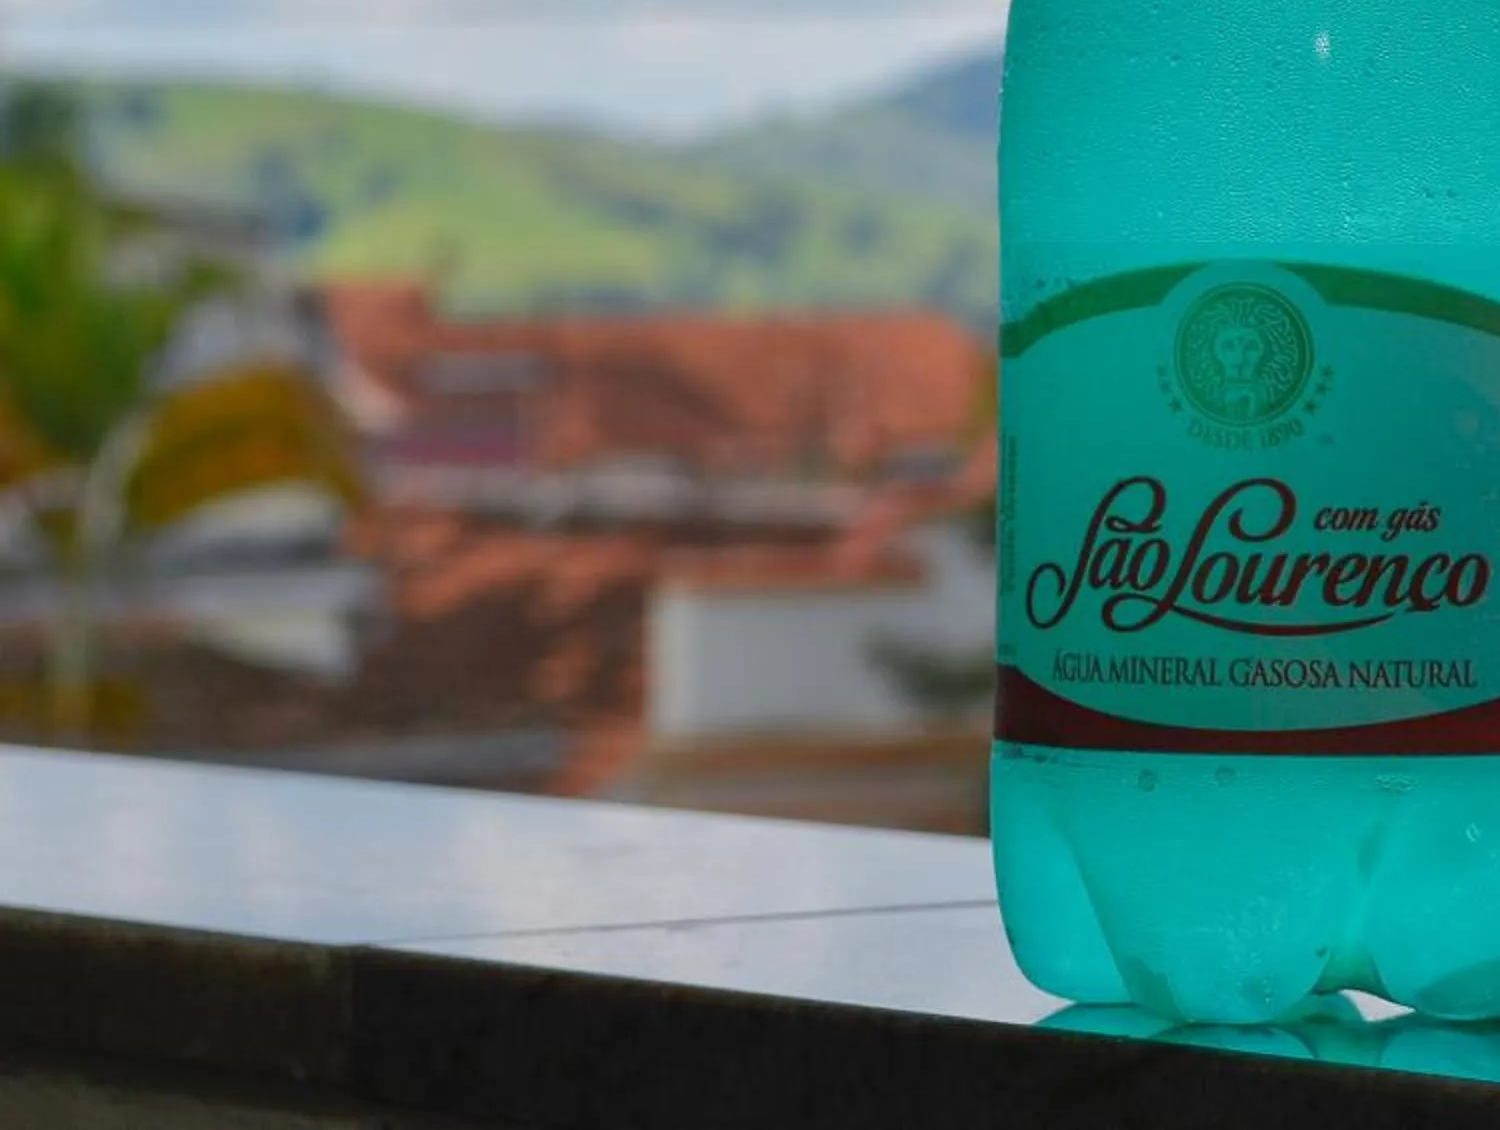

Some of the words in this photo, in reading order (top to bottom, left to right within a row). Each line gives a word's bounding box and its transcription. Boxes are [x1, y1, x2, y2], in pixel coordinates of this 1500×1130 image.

[1187, 417, 1253, 451] DESDE
[1260, 417, 1305, 449] 1890
[1313, 504, 1377, 532] com
[1381, 501, 1442, 541] gás
[1025, 475, 1171, 631] São
[1101, 477, 1491, 637] Lourenço
[1052, 648, 1104, 679] ÁGUA
[1104, 654, 1222, 686] MINERAL
[1229, 655, 1341, 688] GASOSA
[1348, 658, 1478, 688] NATURAL
